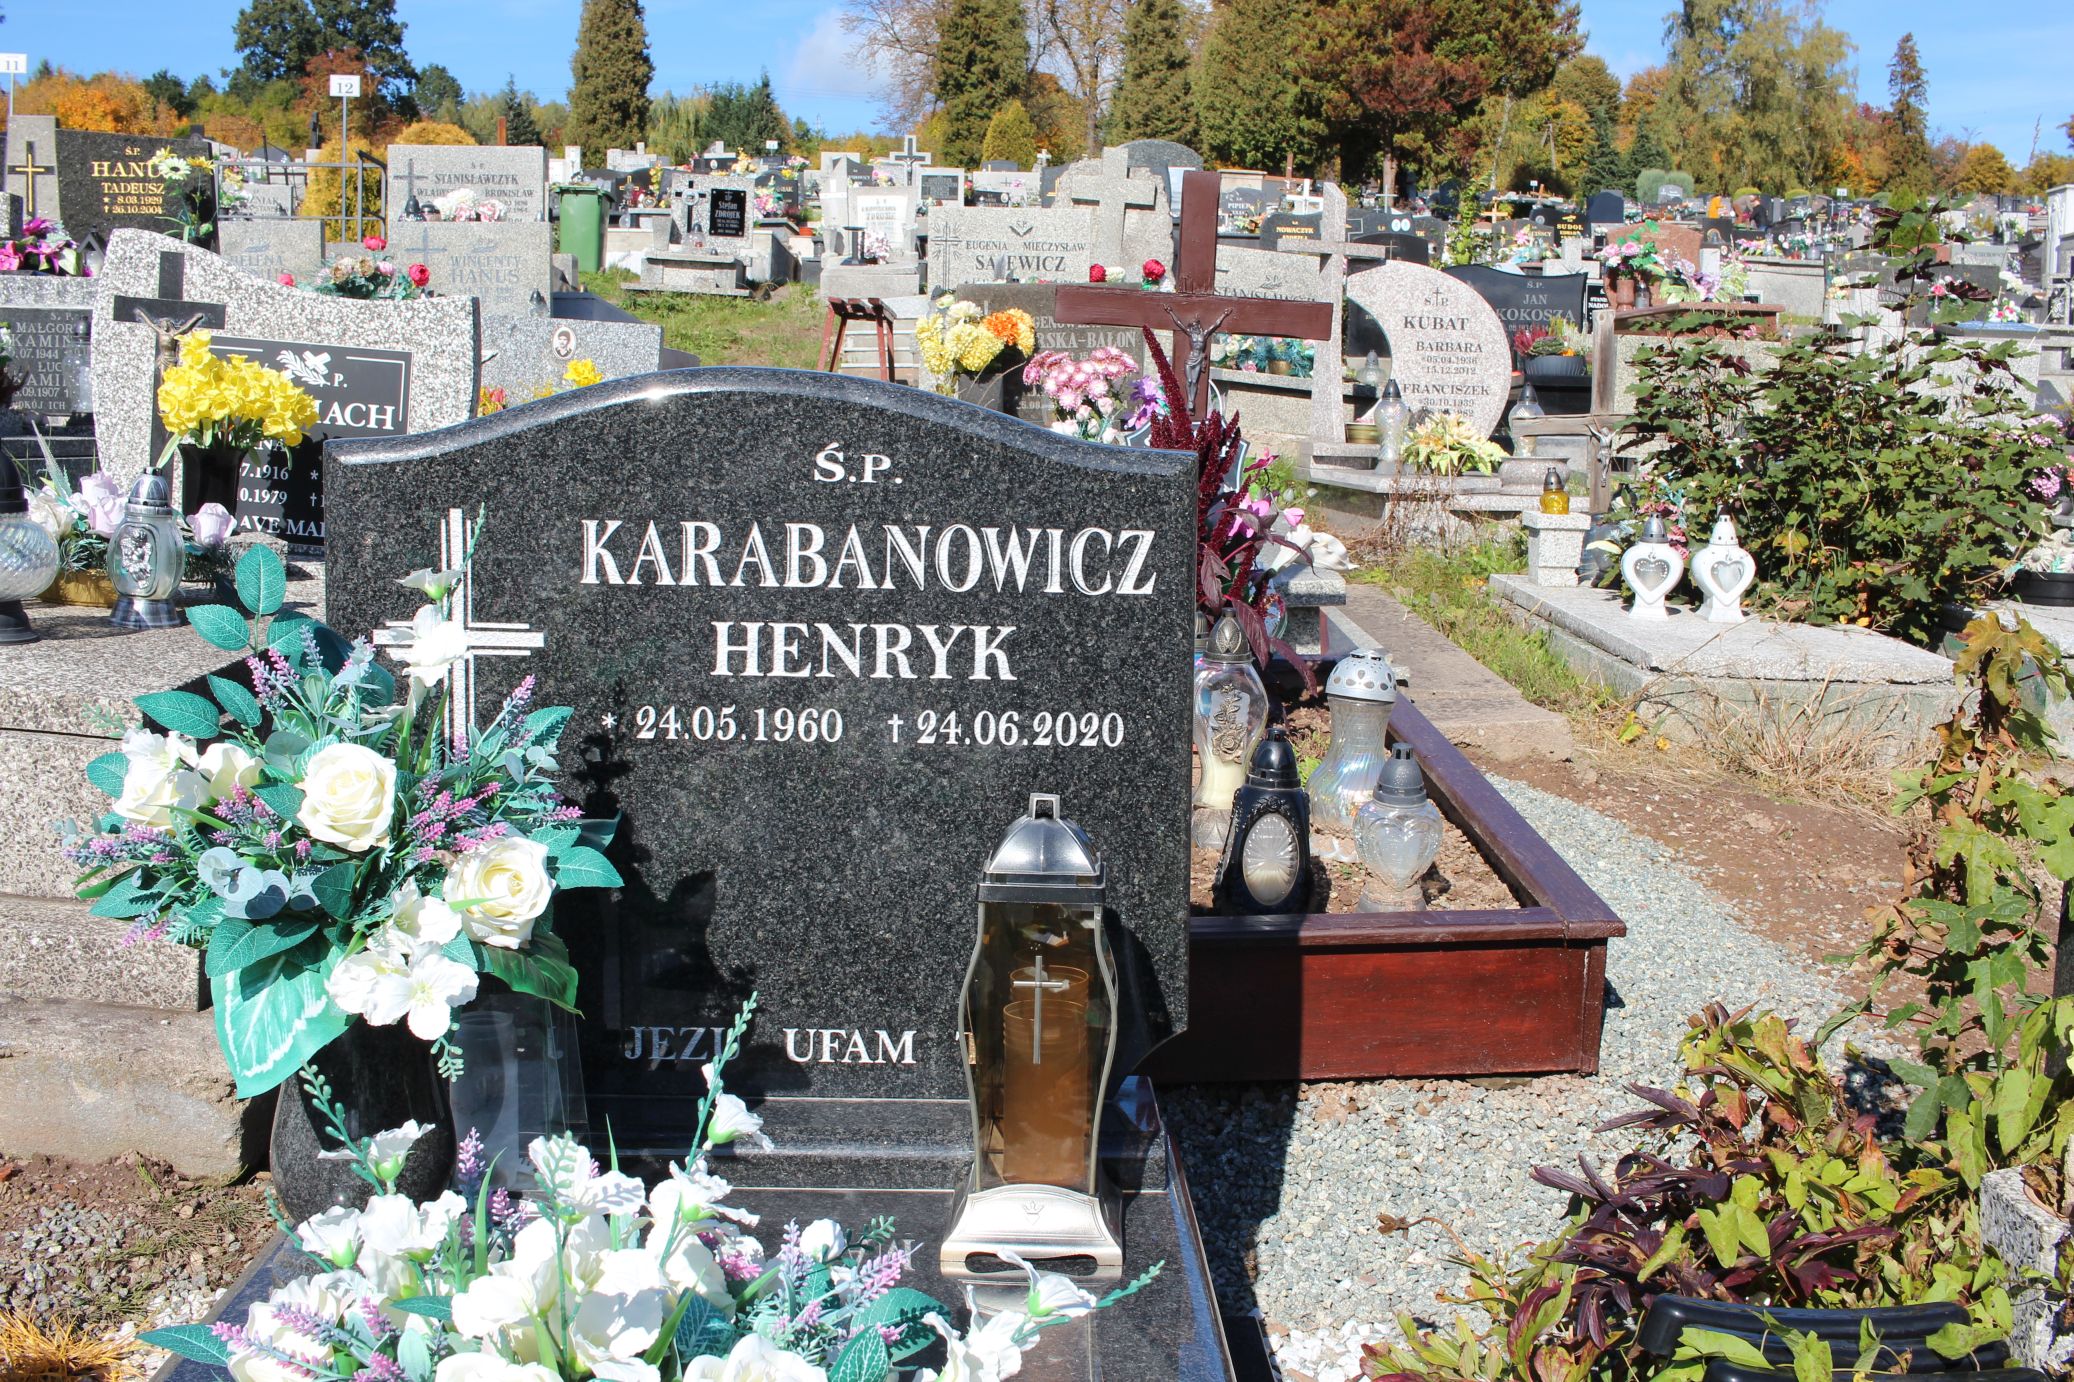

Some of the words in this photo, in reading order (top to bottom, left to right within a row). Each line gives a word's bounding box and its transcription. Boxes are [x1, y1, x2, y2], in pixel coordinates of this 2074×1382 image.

[6, 60, 18, 71] 11
[337, 82, 354, 94] 12
[91, 161, 162, 178] HANU
[101, 182, 165, 195] TADEUSZ
[117, 195, 163, 205] 8.03.1929
[112, 205, 163, 215] 26.10.2004
[966, 240, 1008, 251] EUGENIA
[976, 254, 1066, 272] SAEWICZ
[451, 269, 520, 284] HANUS
[1523, 294, 1549, 305] JAN
[1403, 315, 1470, 331] KUBAT
[1416, 341, 1483, 353] BARBARA
[1402, 383, 1491, 397] FRANCISZEK
[49, 401, 66, 411] ICH
[813, 442, 903, 484] Ś.P.
[240, 514, 281, 534] AVE
[580, 518, 1157, 597] KARABANOWICZ
[710, 620, 1018, 682] HENRYK
[635, 703, 844, 743] 24.05.1960
[916, 708, 1126, 748] 24.06.2020
[782, 1027, 918, 1065] UFAM
